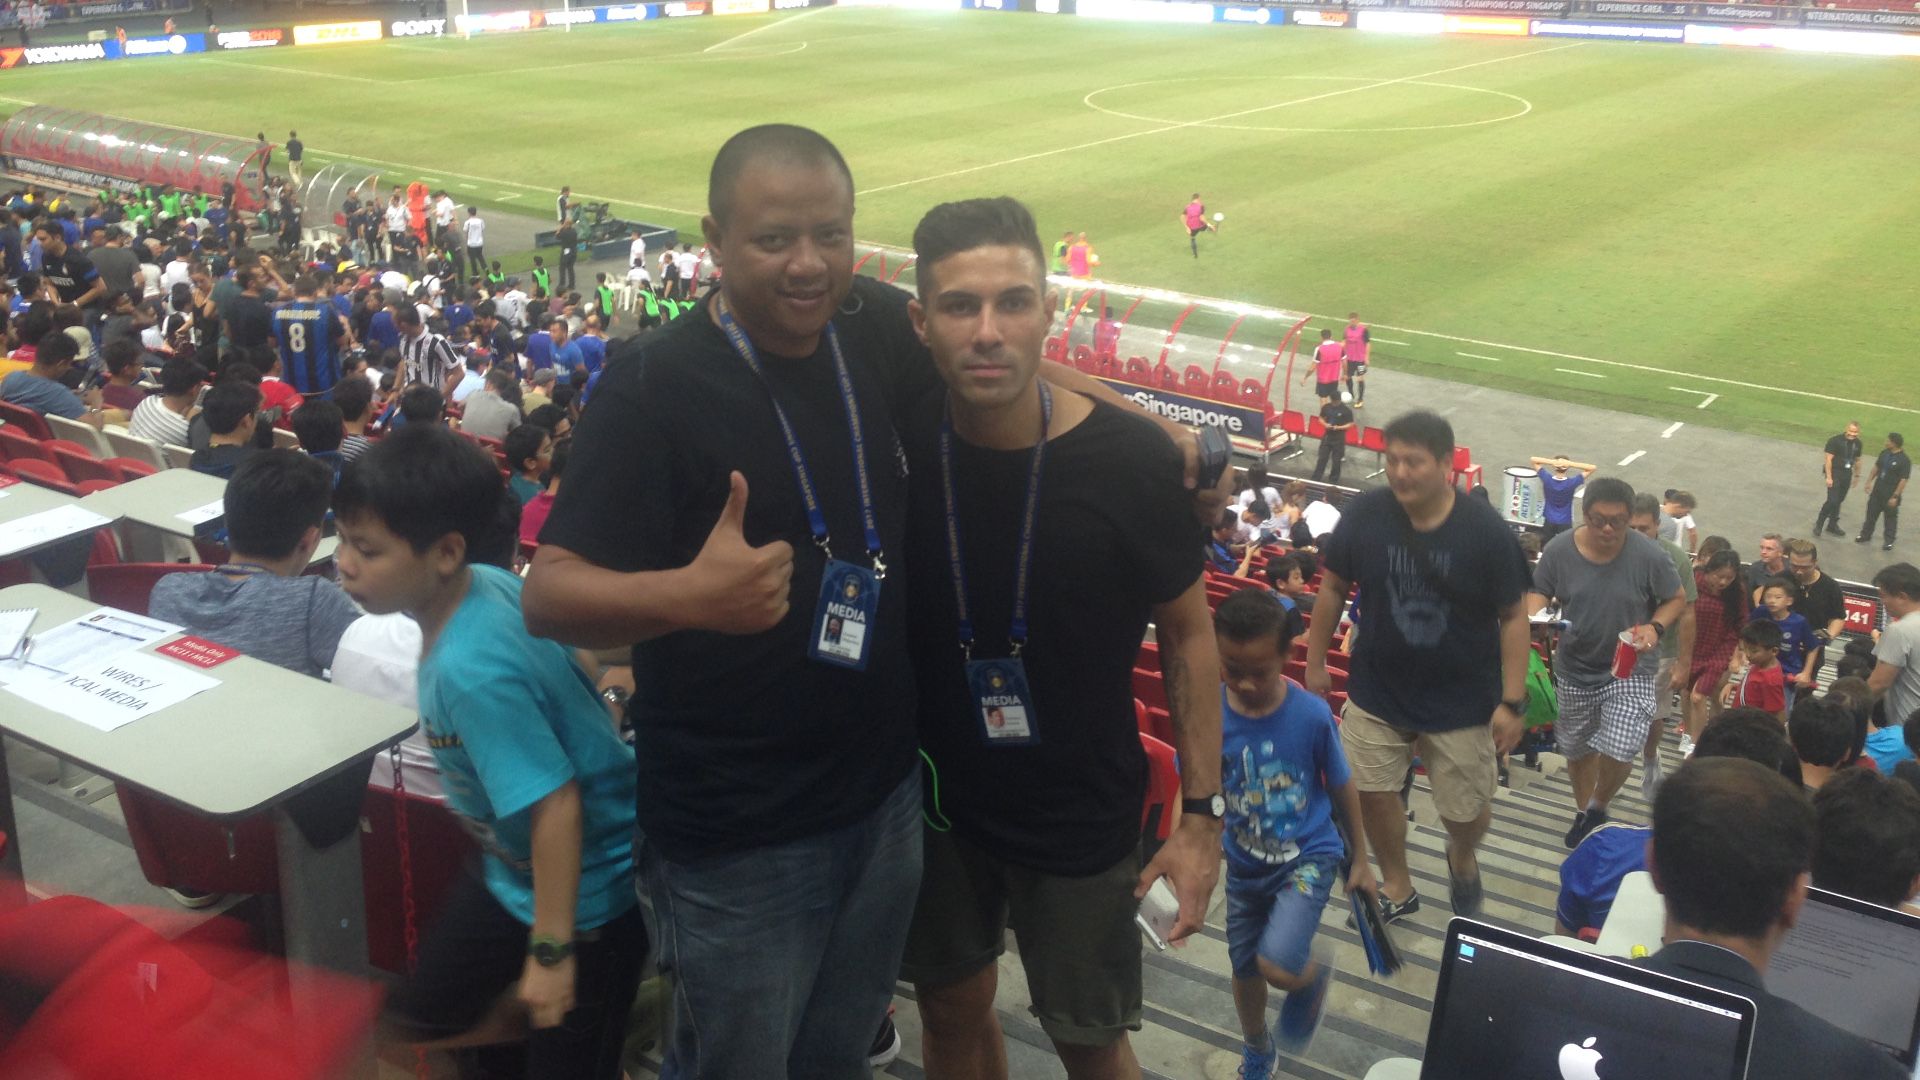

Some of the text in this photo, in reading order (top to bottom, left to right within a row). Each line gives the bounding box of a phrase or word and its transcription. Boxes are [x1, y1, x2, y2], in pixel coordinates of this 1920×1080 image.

[1526, 1, 1568, 11] SINGAPOR
[1596, 4, 1639, 13] EXPERIENCE
[1705, 6, 1772, 19] YourSingapore
[1806, 11, 1872, 23] NTERNATIONAL
[392, 19, 447, 37] SONY
[289, 322, 306, 353] 8
[827, 601, 866, 623] MEDIA
[1844, 609, 1869, 625] 141
[100, 666, 151, 688] WIRES
[96, 688, 149, 711] MEDIA
[981, 695, 1022, 707] MEDIA
